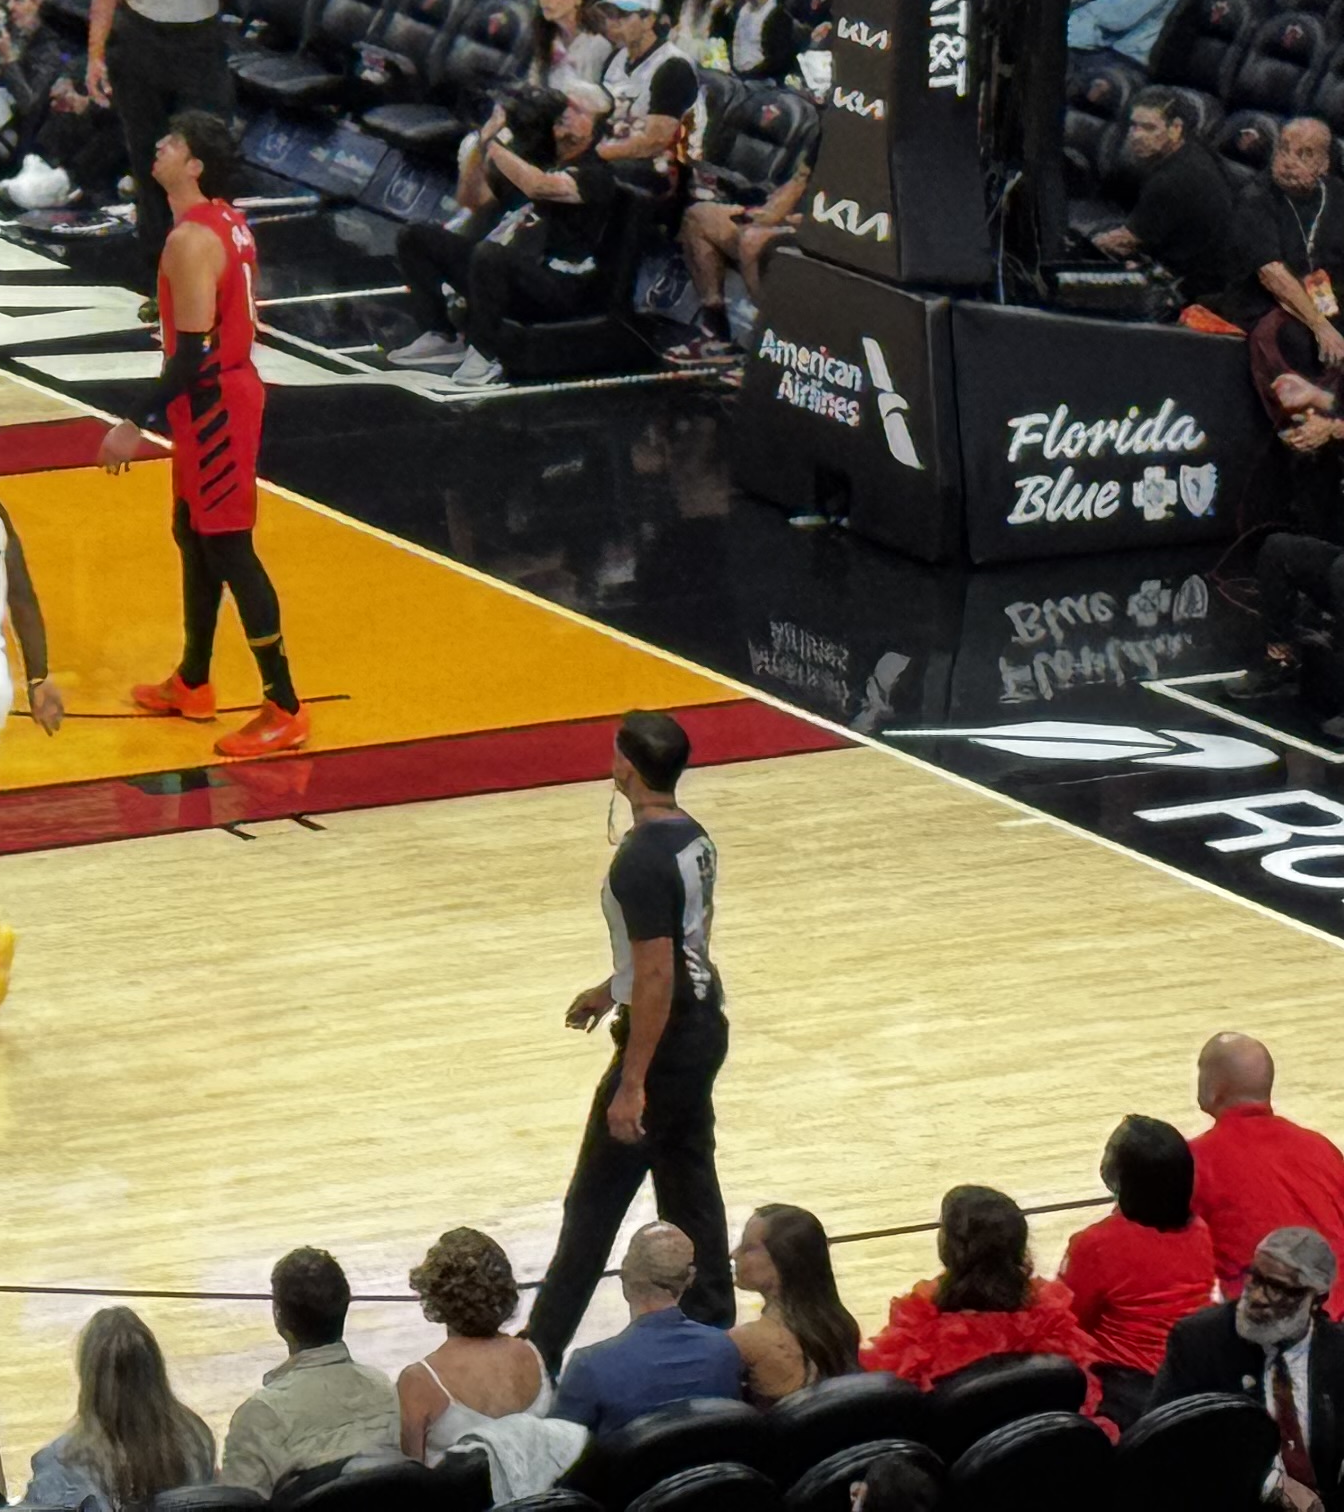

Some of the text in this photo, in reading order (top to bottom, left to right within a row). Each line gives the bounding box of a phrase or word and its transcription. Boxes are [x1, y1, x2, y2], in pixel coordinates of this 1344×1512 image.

[758, 328, 863, 392] American
[775, 370, 861, 427] Airlines
[1007, 397, 1207, 462] Florida
[1007, 465, 1121, 524] Blue
